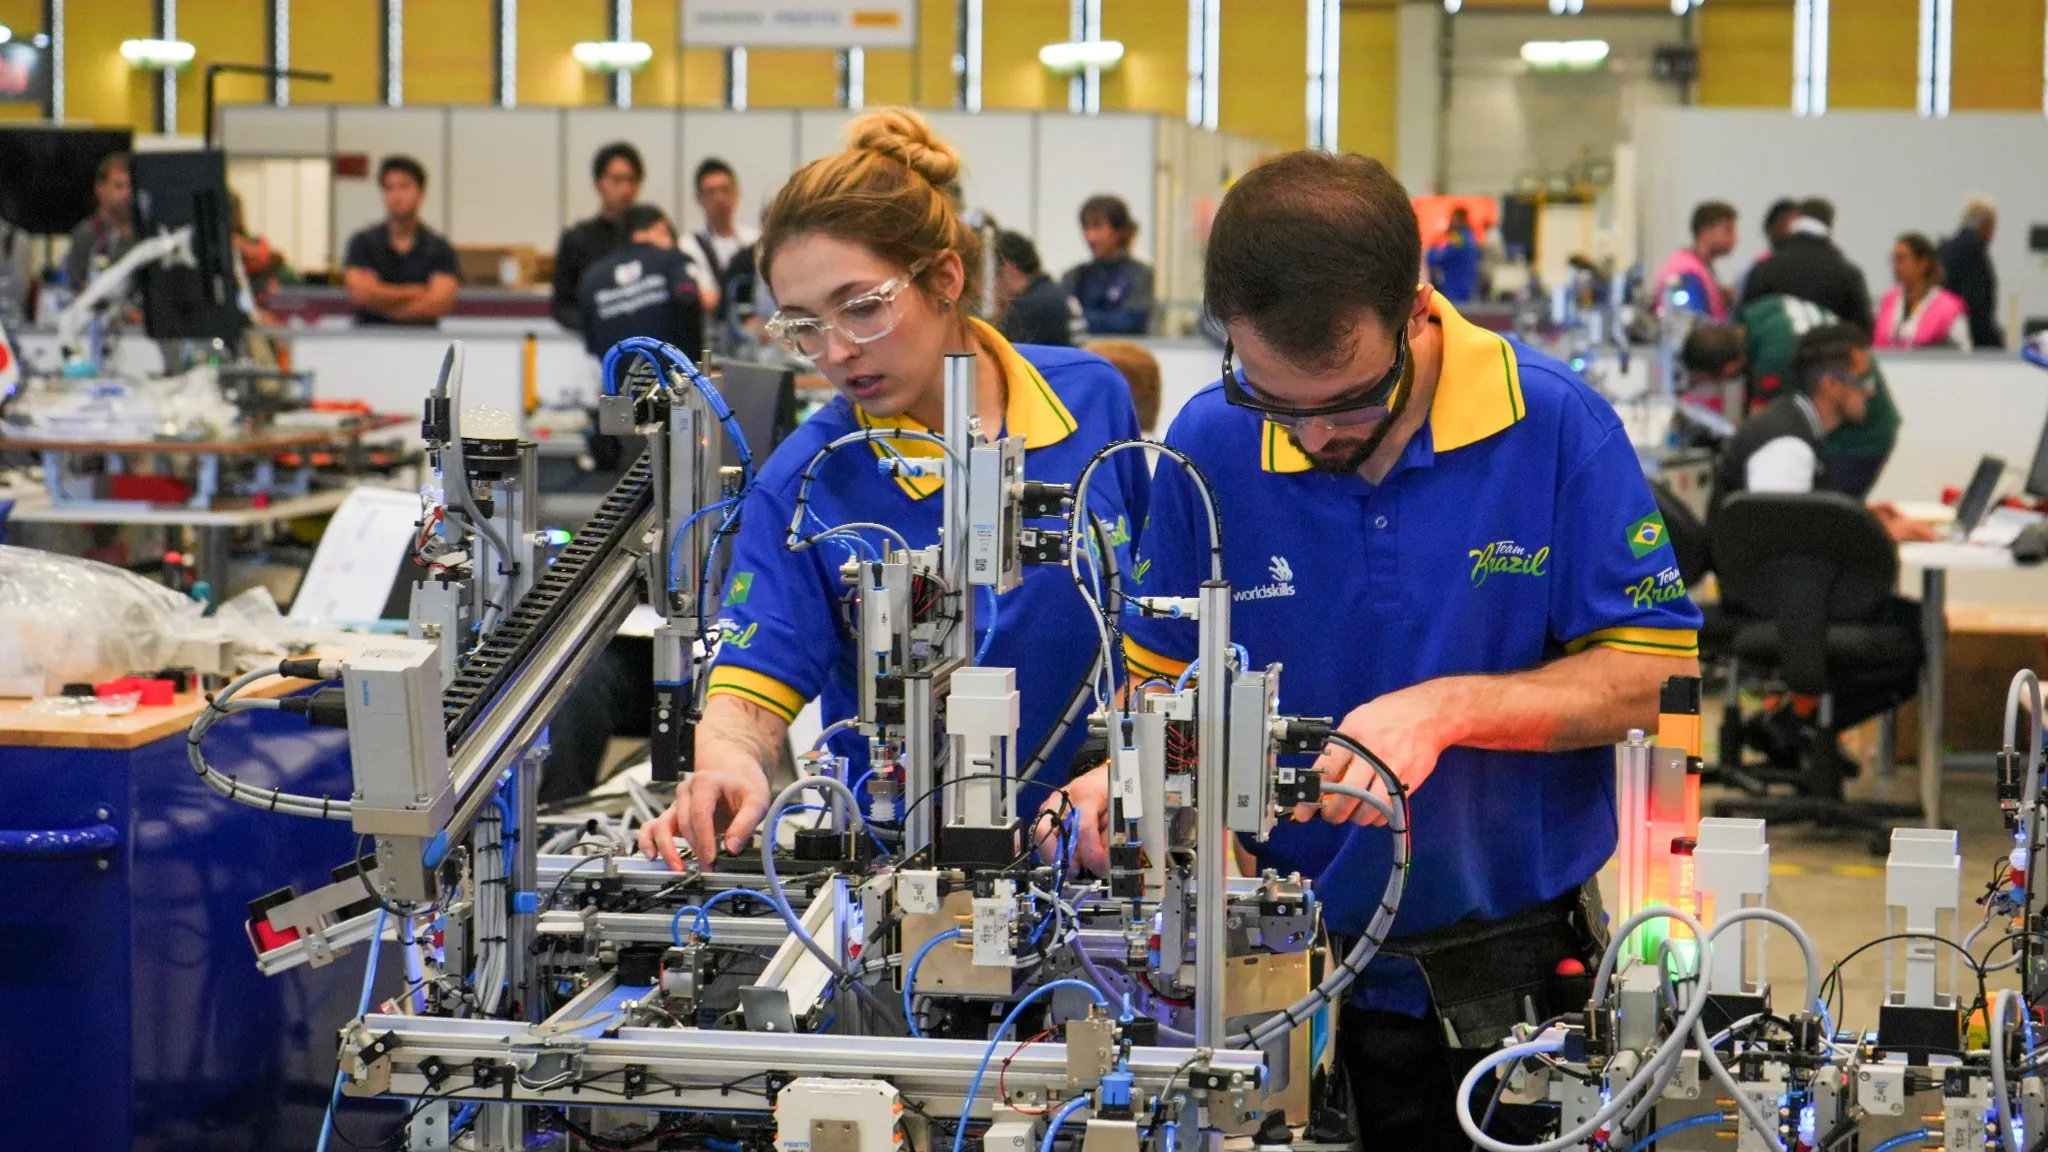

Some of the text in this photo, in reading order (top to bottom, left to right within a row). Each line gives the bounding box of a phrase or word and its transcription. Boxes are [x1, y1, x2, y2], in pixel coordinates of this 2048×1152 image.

[1495, 541, 1526, 556] Team
[1469, 543, 1550, 588] Brazil
[1233, 582, 1296, 602] worldskills
